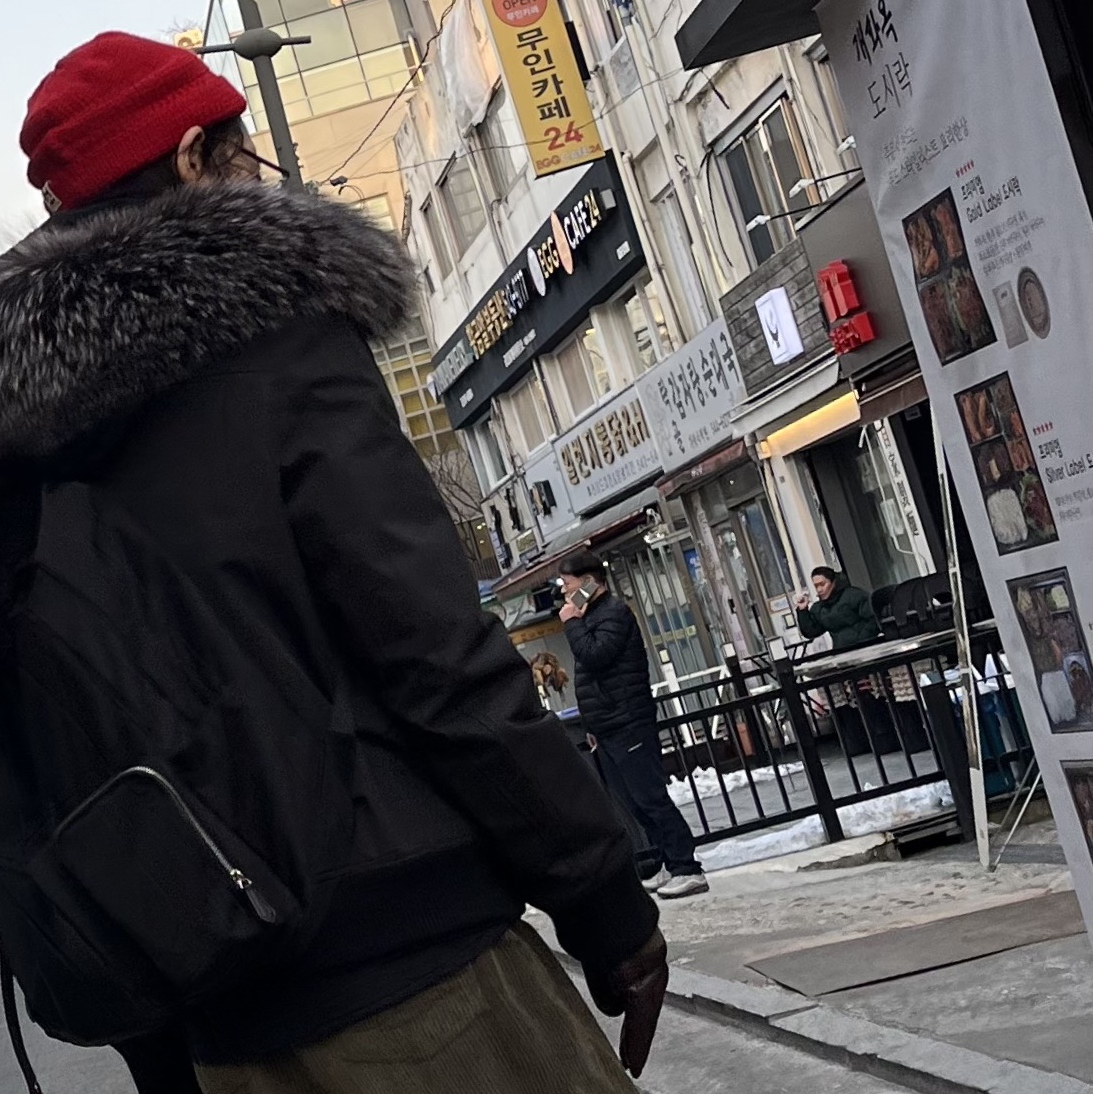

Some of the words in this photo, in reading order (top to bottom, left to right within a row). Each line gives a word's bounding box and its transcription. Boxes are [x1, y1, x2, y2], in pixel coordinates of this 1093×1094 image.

[516, 27, 571, 121] 무인카페
[867, 52, 913, 119] 도시락
[543, 121, 584, 151] 24
[536, 154, 562, 170] EGG
[536, 236, 560, 279] EGG
